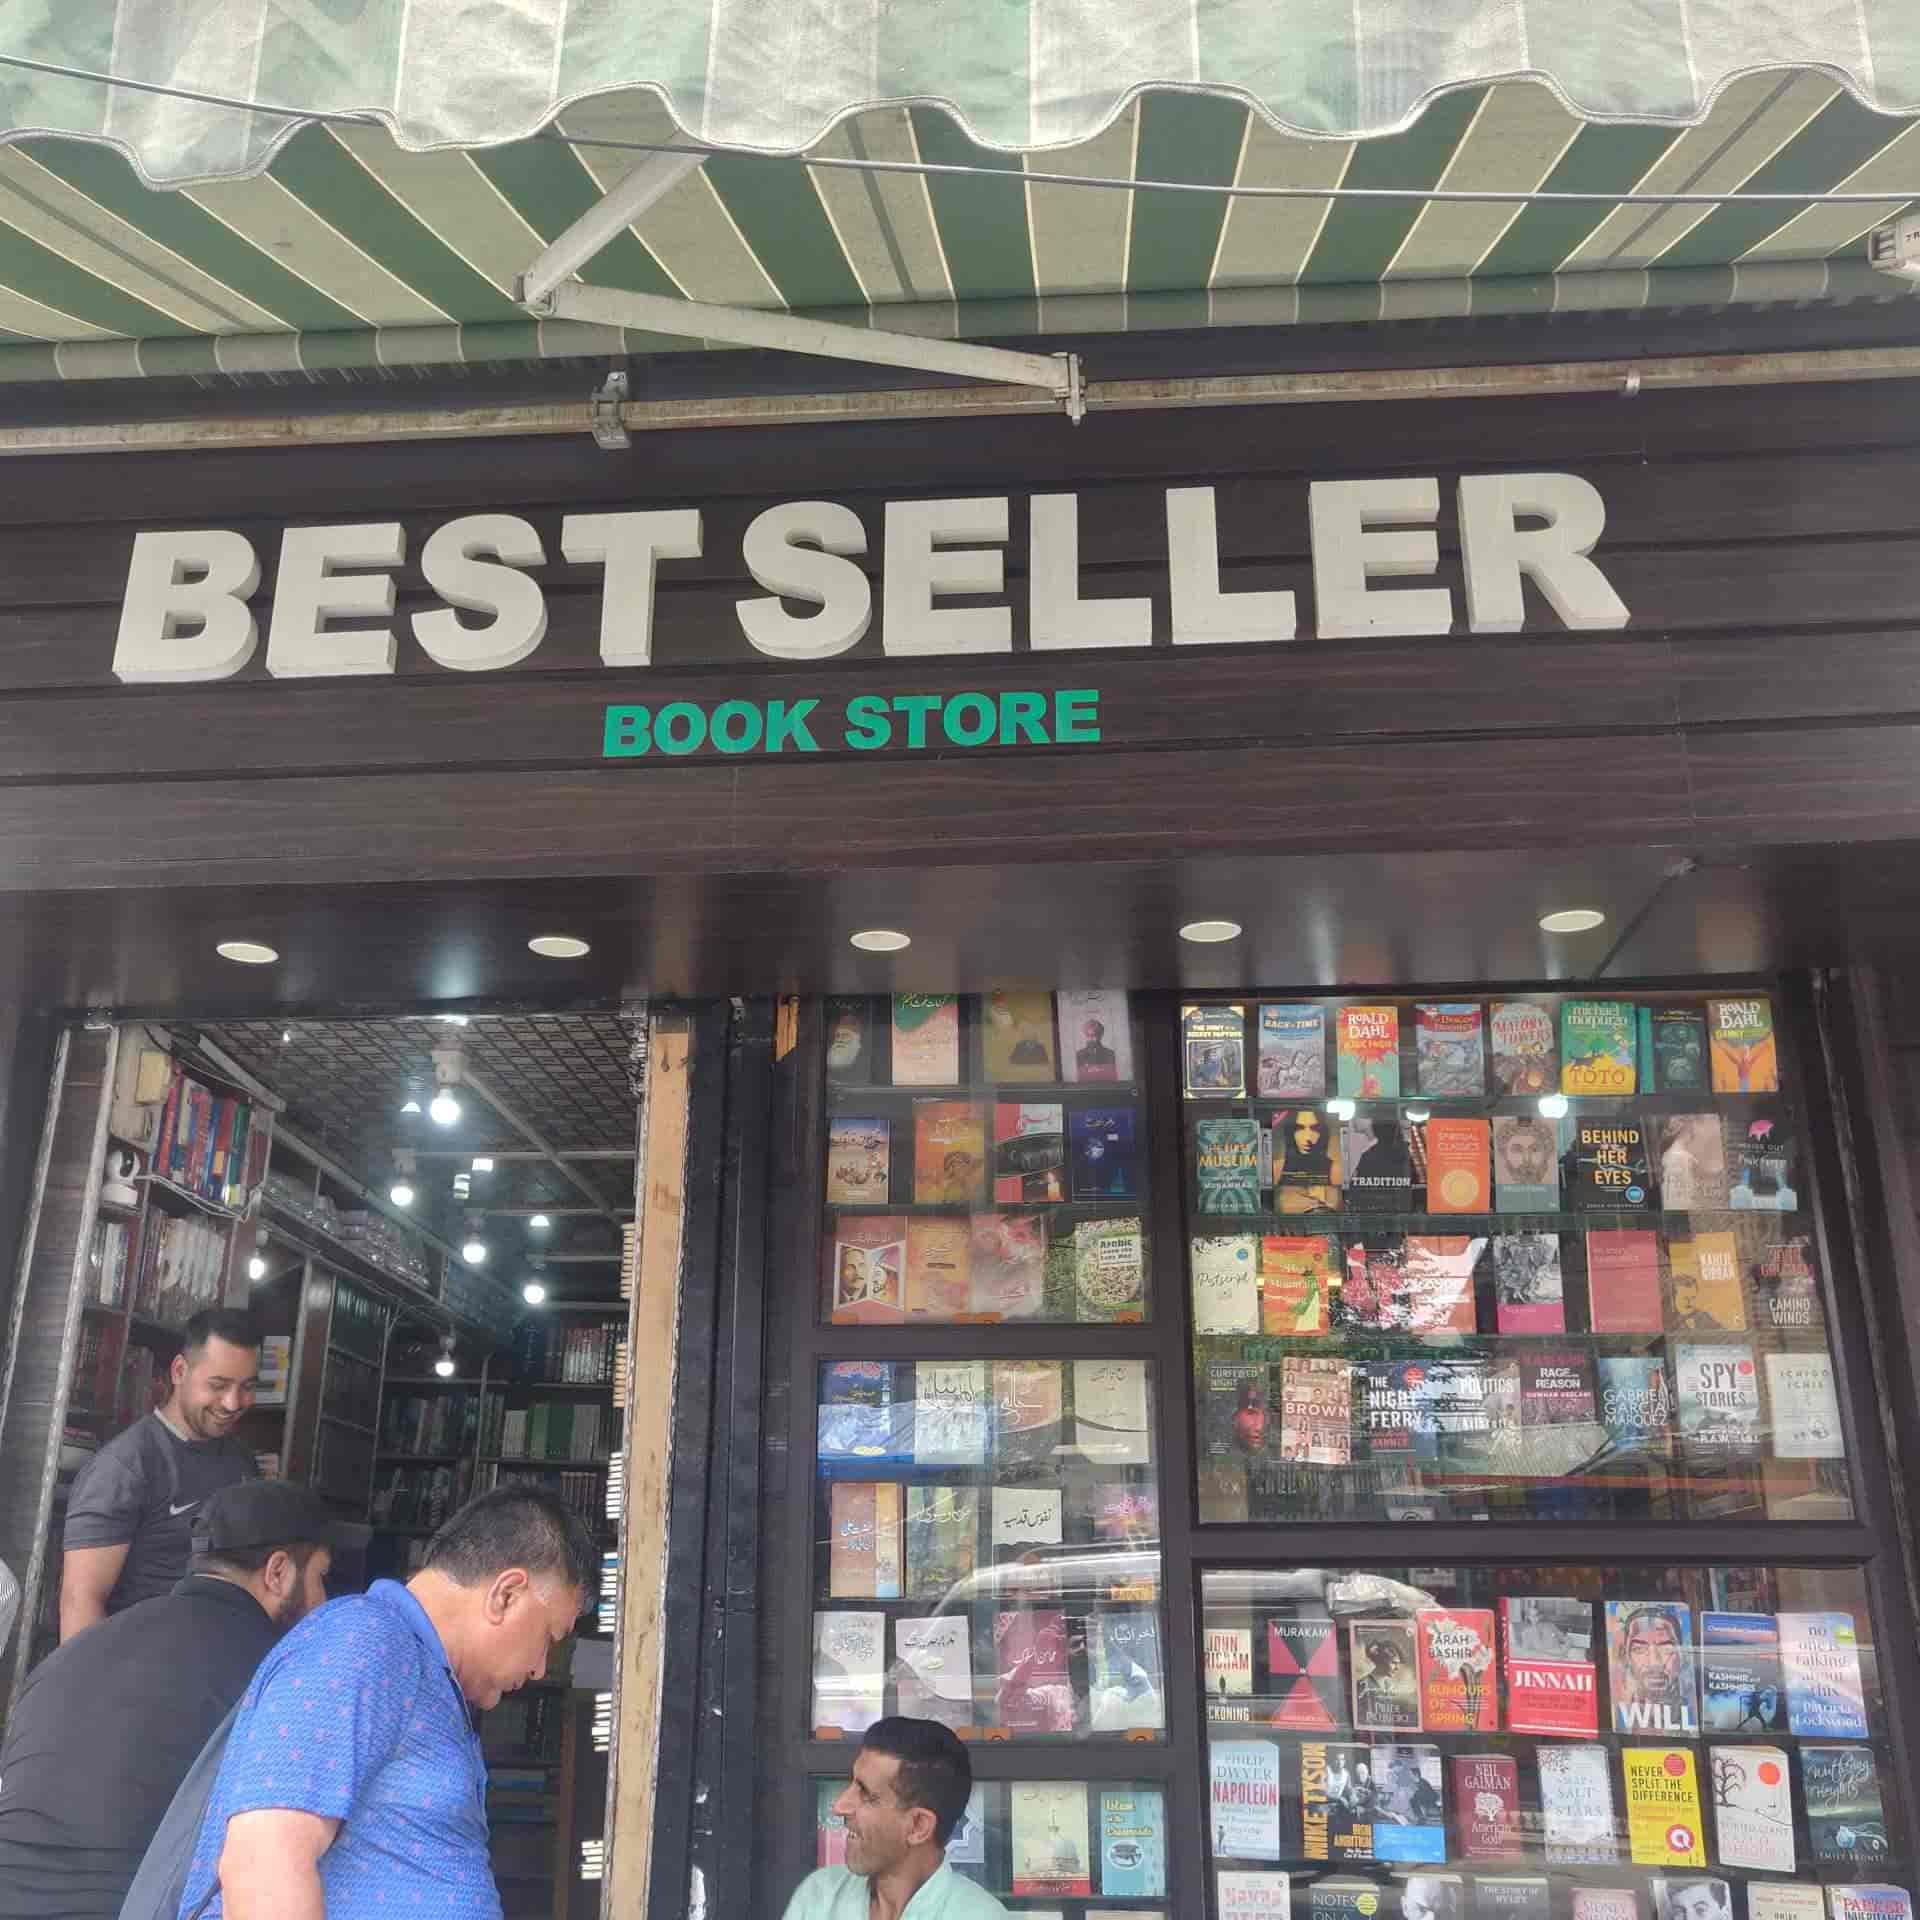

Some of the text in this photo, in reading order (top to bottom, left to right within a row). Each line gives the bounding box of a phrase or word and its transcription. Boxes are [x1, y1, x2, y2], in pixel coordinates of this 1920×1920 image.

[113, 472, 1630, 684] BEST SELLER
[601, 688, 1101, 759] BOOK STORE
[1719, 1002, 1761, 1015] ROALD
[1347, 1012, 1389, 1025] ROALD
[1720, 1014, 1763, 1029] DAHL
[1349, 1024, 1391, 1040] DAHL
[1568, 1066, 1625, 1085] TOTO
[1581, 1128, 1639, 1145] BEHIND
[1199, 1153, 1257, 1168] MUSLIM
[1596, 1149, 1627, 1165] HER
[1351, 1176, 1410, 1187] TRADITION
[1593, 1169, 1632, 1185] EYES
[1769, 1297, 1810, 1312] CAMINO
[1772, 1311, 1809, 1325] WINDS
[1540, 1367, 1569, 1379] RAGE
[1700, 1362, 1736, 1389] SPY
[1368, 1376, 1389, 1388] THE
[1536, 1379, 1581, 1389] REASON
[1369, 1390, 1417, 1409] NIGHT
[1603, 1388, 1667, 1402] GABRIEL
[1696, 1391, 1746, 1408] STORIES
[1285, 1401, 1349, 1417] BROWN
[1370, 1410, 1424, 1428] FERRY
[1274, 1626, 1331, 1639] MURAKAMI
[1513, 1670, 1594, 1692] JINNAH
[1429, 1712, 1475, 1725] SPRING
[1617, 1702, 1698, 1730] WILL
[1224, 1753, 1265, 1764] PHILIP
[1215, 1766, 1272, 1780] DWYER
[1474, 1763, 1498, 1777] NEIL
[1630, 1765, 1664, 1777] NEVER
[1464, 1776, 1512, 1790] GAIMAN
[1631, 1778, 1683, 1790] SPLIT THE
[1212, 1781, 1278, 1807] NAPOLEON
[1302, 1743, 1328, 1860] MIKE TYSON
[1632, 1790, 1694, 1802] DIFFERENCE
[1312, 1894, 1356, 1906] NOTES
